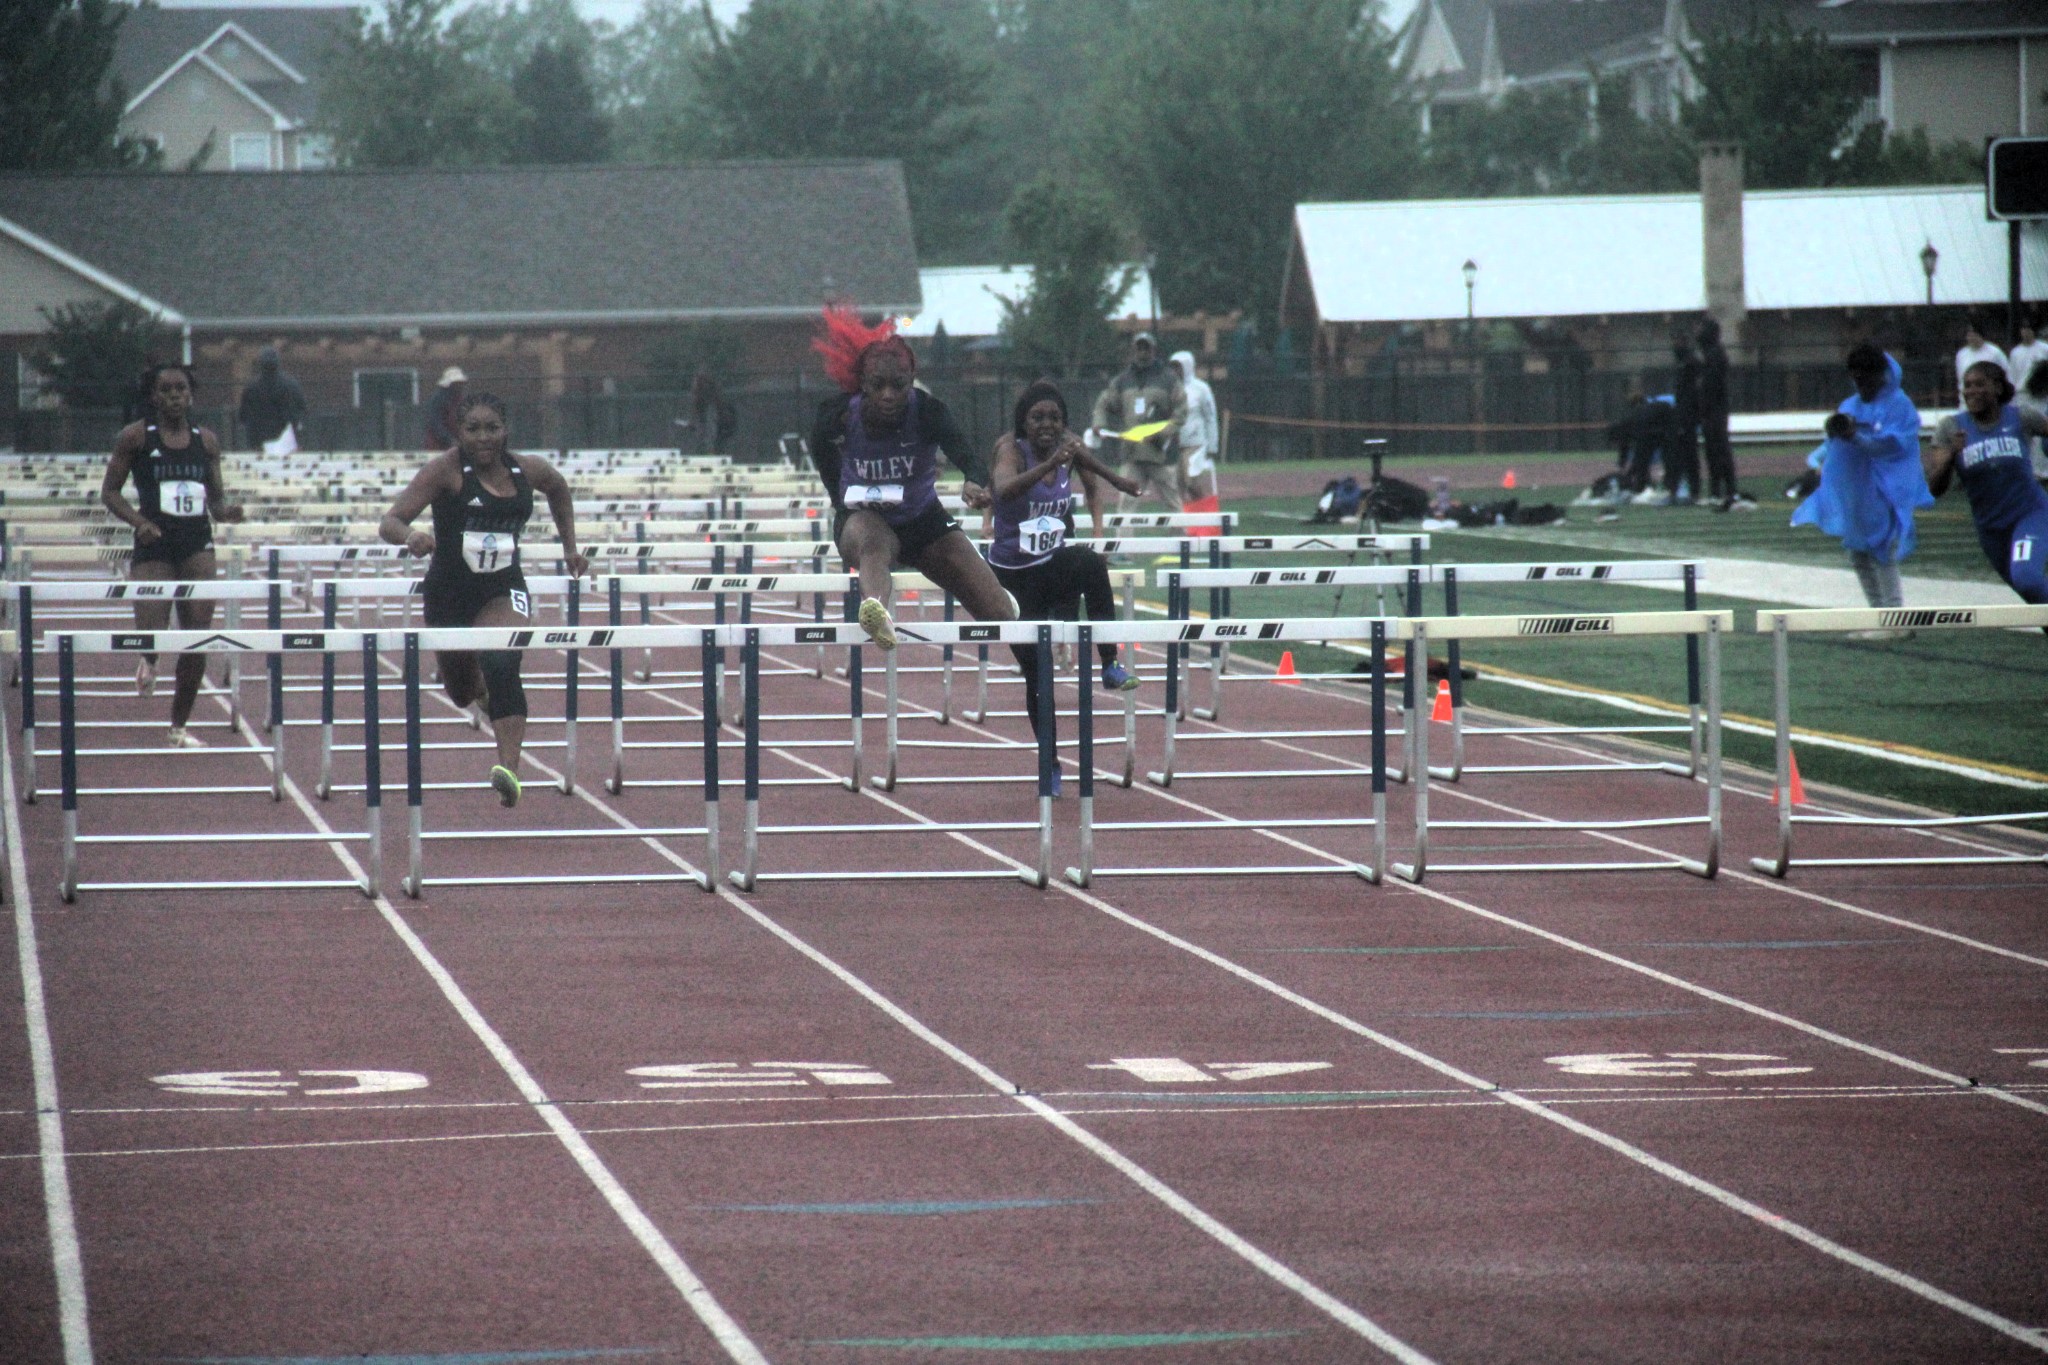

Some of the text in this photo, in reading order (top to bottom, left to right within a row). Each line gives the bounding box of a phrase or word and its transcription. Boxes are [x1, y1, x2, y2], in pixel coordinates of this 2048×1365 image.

[855, 455, 917, 480] WILEY
[173, 495, 194, 513] 15
[1028, 497, 1073, 517] WILEY
[1028, 531, 1057, 552] 169
[606, 547, 629, 555] GILL
[477, 550, 498, 569] 11
[1280, 572, 1306, 581] GILL
[1555, 567, 1582, 576] GILL
[721, 579, 748, 587] GILL
[136, 586, 164, 595] GILL
[513, 592, 526, 613] 5
[1936, 612, 1973, 624] GILL
[1215, 625, 1247, 636] GILL
[1573, 619, 1611, 631] GILL
[123, 638, 143, 646] GILL
[293, 637, 313, 646] GILL
[545, 632, 577, 643] GILL
[1086, 1056, 1334, 1084] 4
